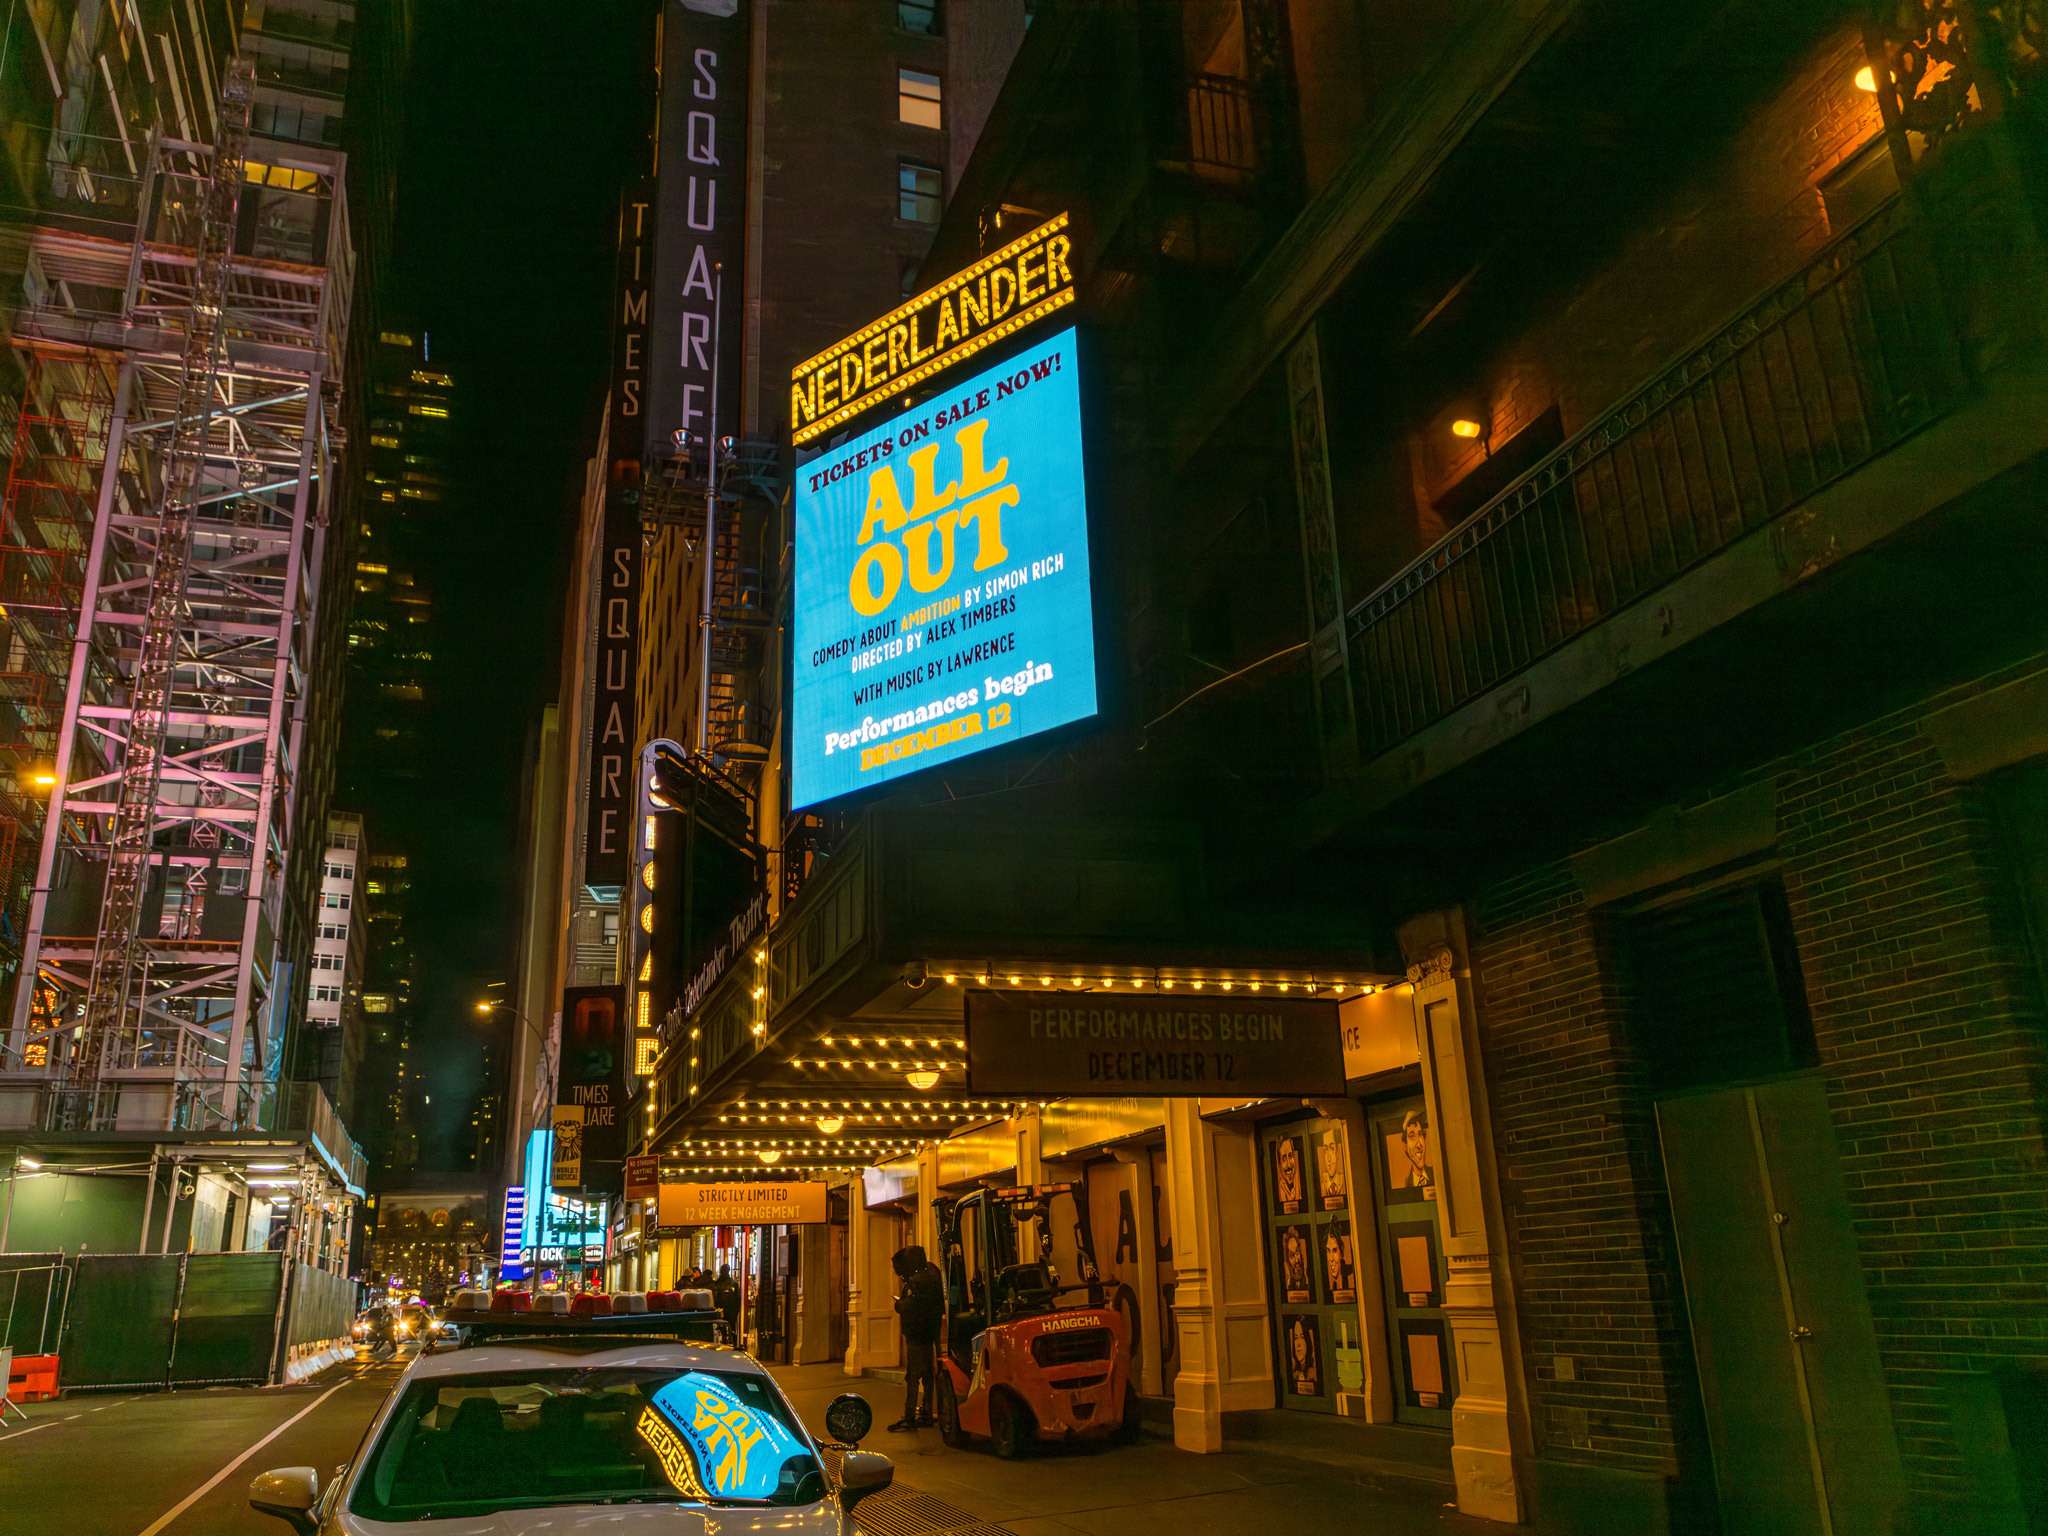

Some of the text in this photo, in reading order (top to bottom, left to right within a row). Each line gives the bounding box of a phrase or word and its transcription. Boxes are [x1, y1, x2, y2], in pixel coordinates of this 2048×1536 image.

[681, 48, 720, 443] SQUARE
[622, 203, 649, 416] TIMES
[791, 234, 1071, 429] NEDERLANDER
[809, 352, 1062, 493] TICKETS ON SALE NOW!
[857, 418, 1009, 545] ALL
[849, 484, 1020, 616] OUT
[812, 553, 1064, 667] COMEDY ABOUT AMBITION BY SIMON RICH
[851, 595, 1016, 674] DIRECTED BY ALEX TIMBERS
[600, 548, 631, 854] SQUARE
[824, 660, 1054, 755] Performances begin
[853, 632, 1016, 706] WITH MUSIC BY LAWRENCE
[860, 702, 1011, 771] DECEMBER 12
[1029, 1008, 1284, 1042] PERFORMANCES BEGIN
[573, 1085, 609, 1105] TIMES
[1088, 1051, 1234, 1082] DECEMBER 12
[583, 1106, 615, 1126] UARE
[685, 1204, 801, 1220] 12 WEEK ENGAGEMENT
[699, 1188, 788, 1203] STRICTLY LIMITED
[1042, 1315, 1101, 1332] HANGCHA
